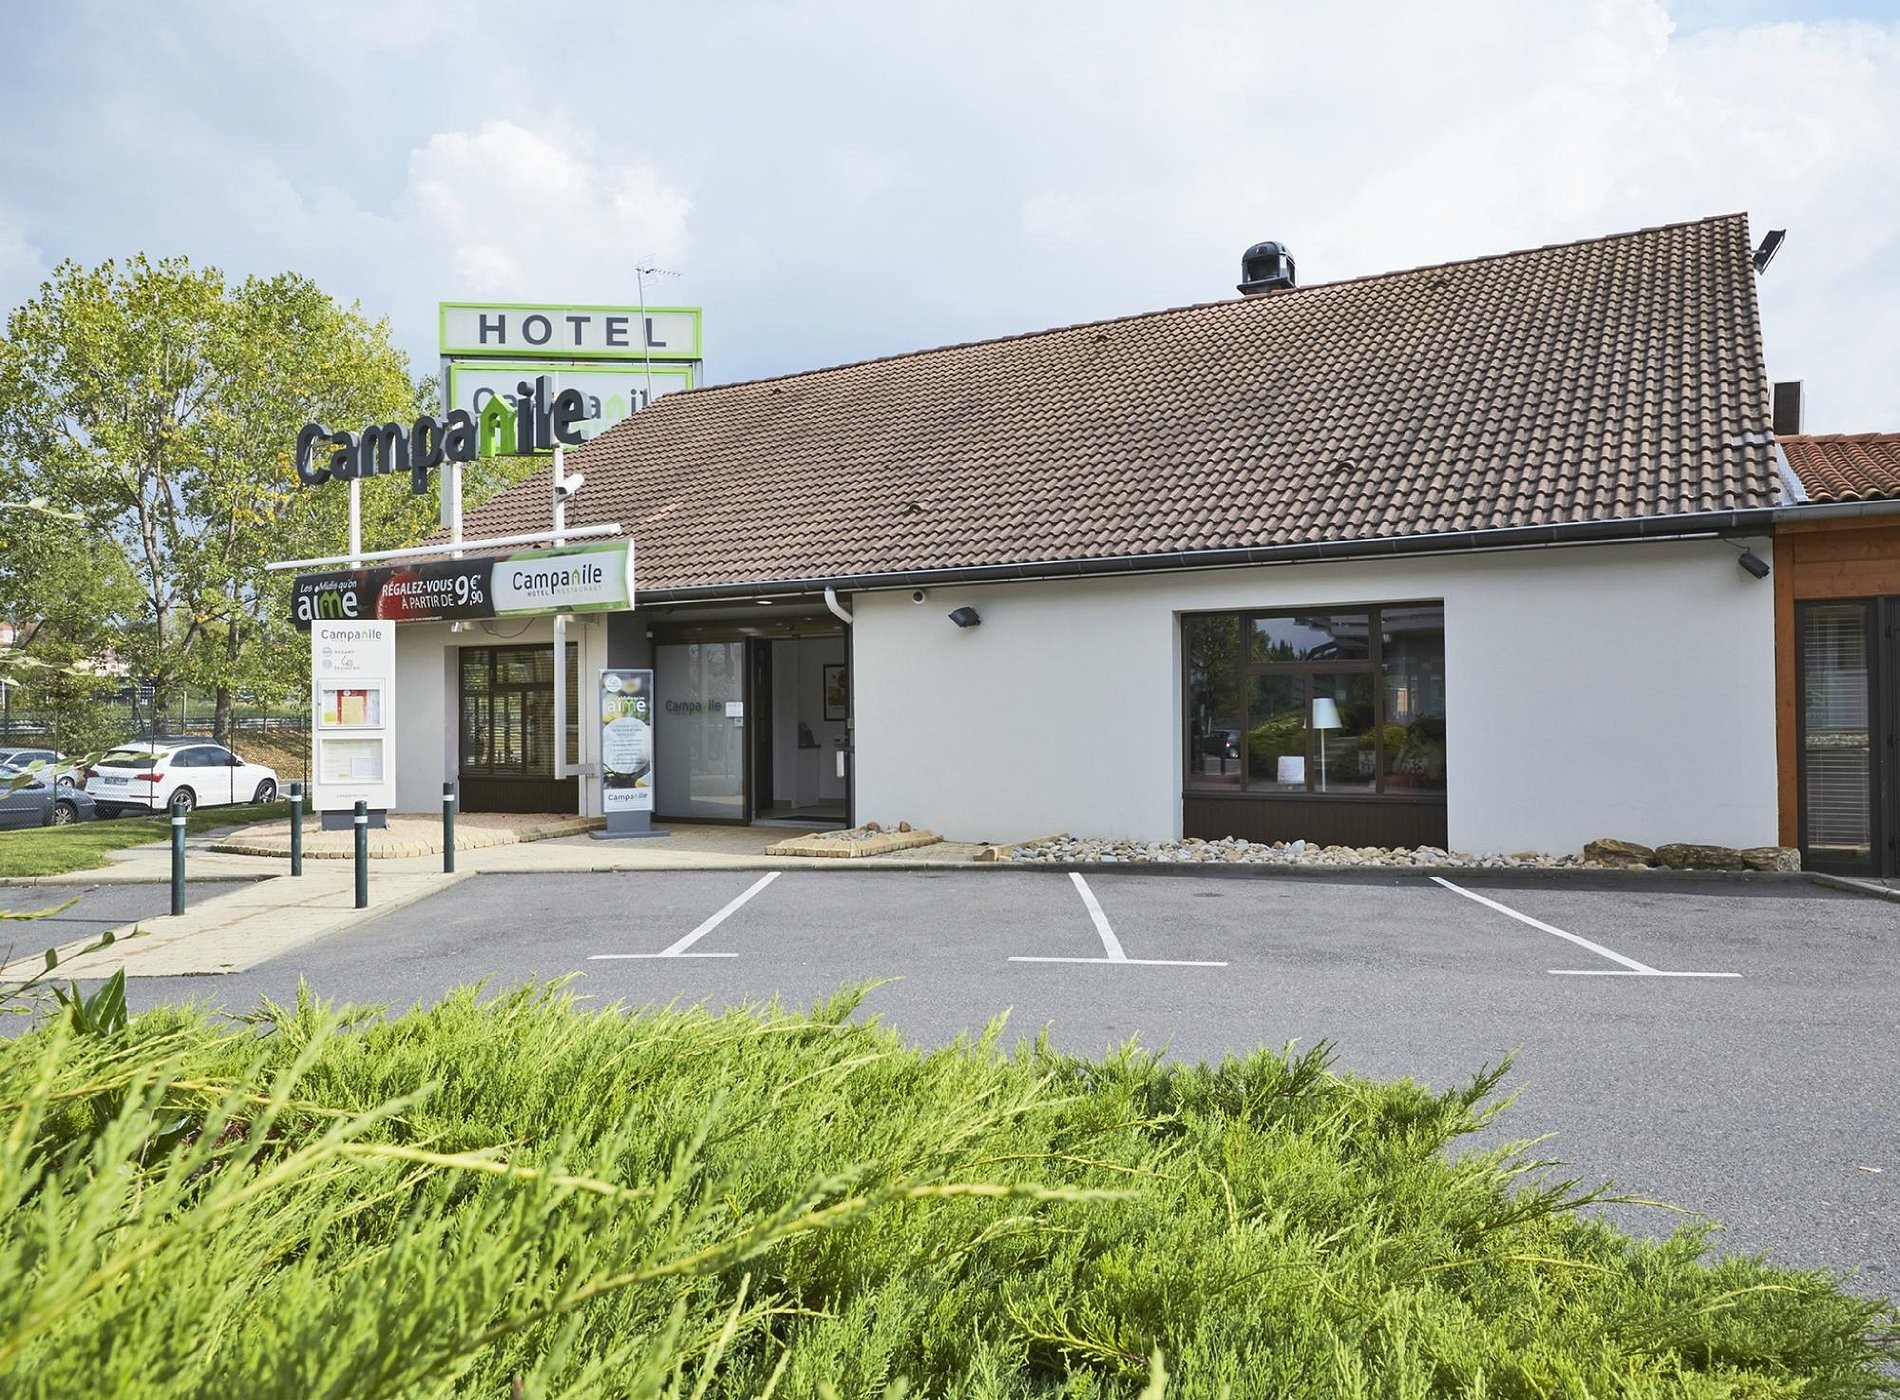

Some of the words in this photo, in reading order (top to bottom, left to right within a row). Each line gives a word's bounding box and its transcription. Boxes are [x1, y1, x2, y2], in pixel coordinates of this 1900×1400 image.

[478, 313, 668, 348] HOTEL
[296, 375, 592, 495] Campanile
[512, 563, 602, 594] Campanile
[300, 584, 313, 593] Les
[382, 579, 453, 597] RÉGALEZ-VOUS
[297, 587, 358, 621] aime
[402, 595, 409, 610] À
[410, 595, 440, 609] PARTIR
[441, 594, 454, 607] DE
[321, 629, 382, 642] Campanile
[607, 697, 646, 712] aime
